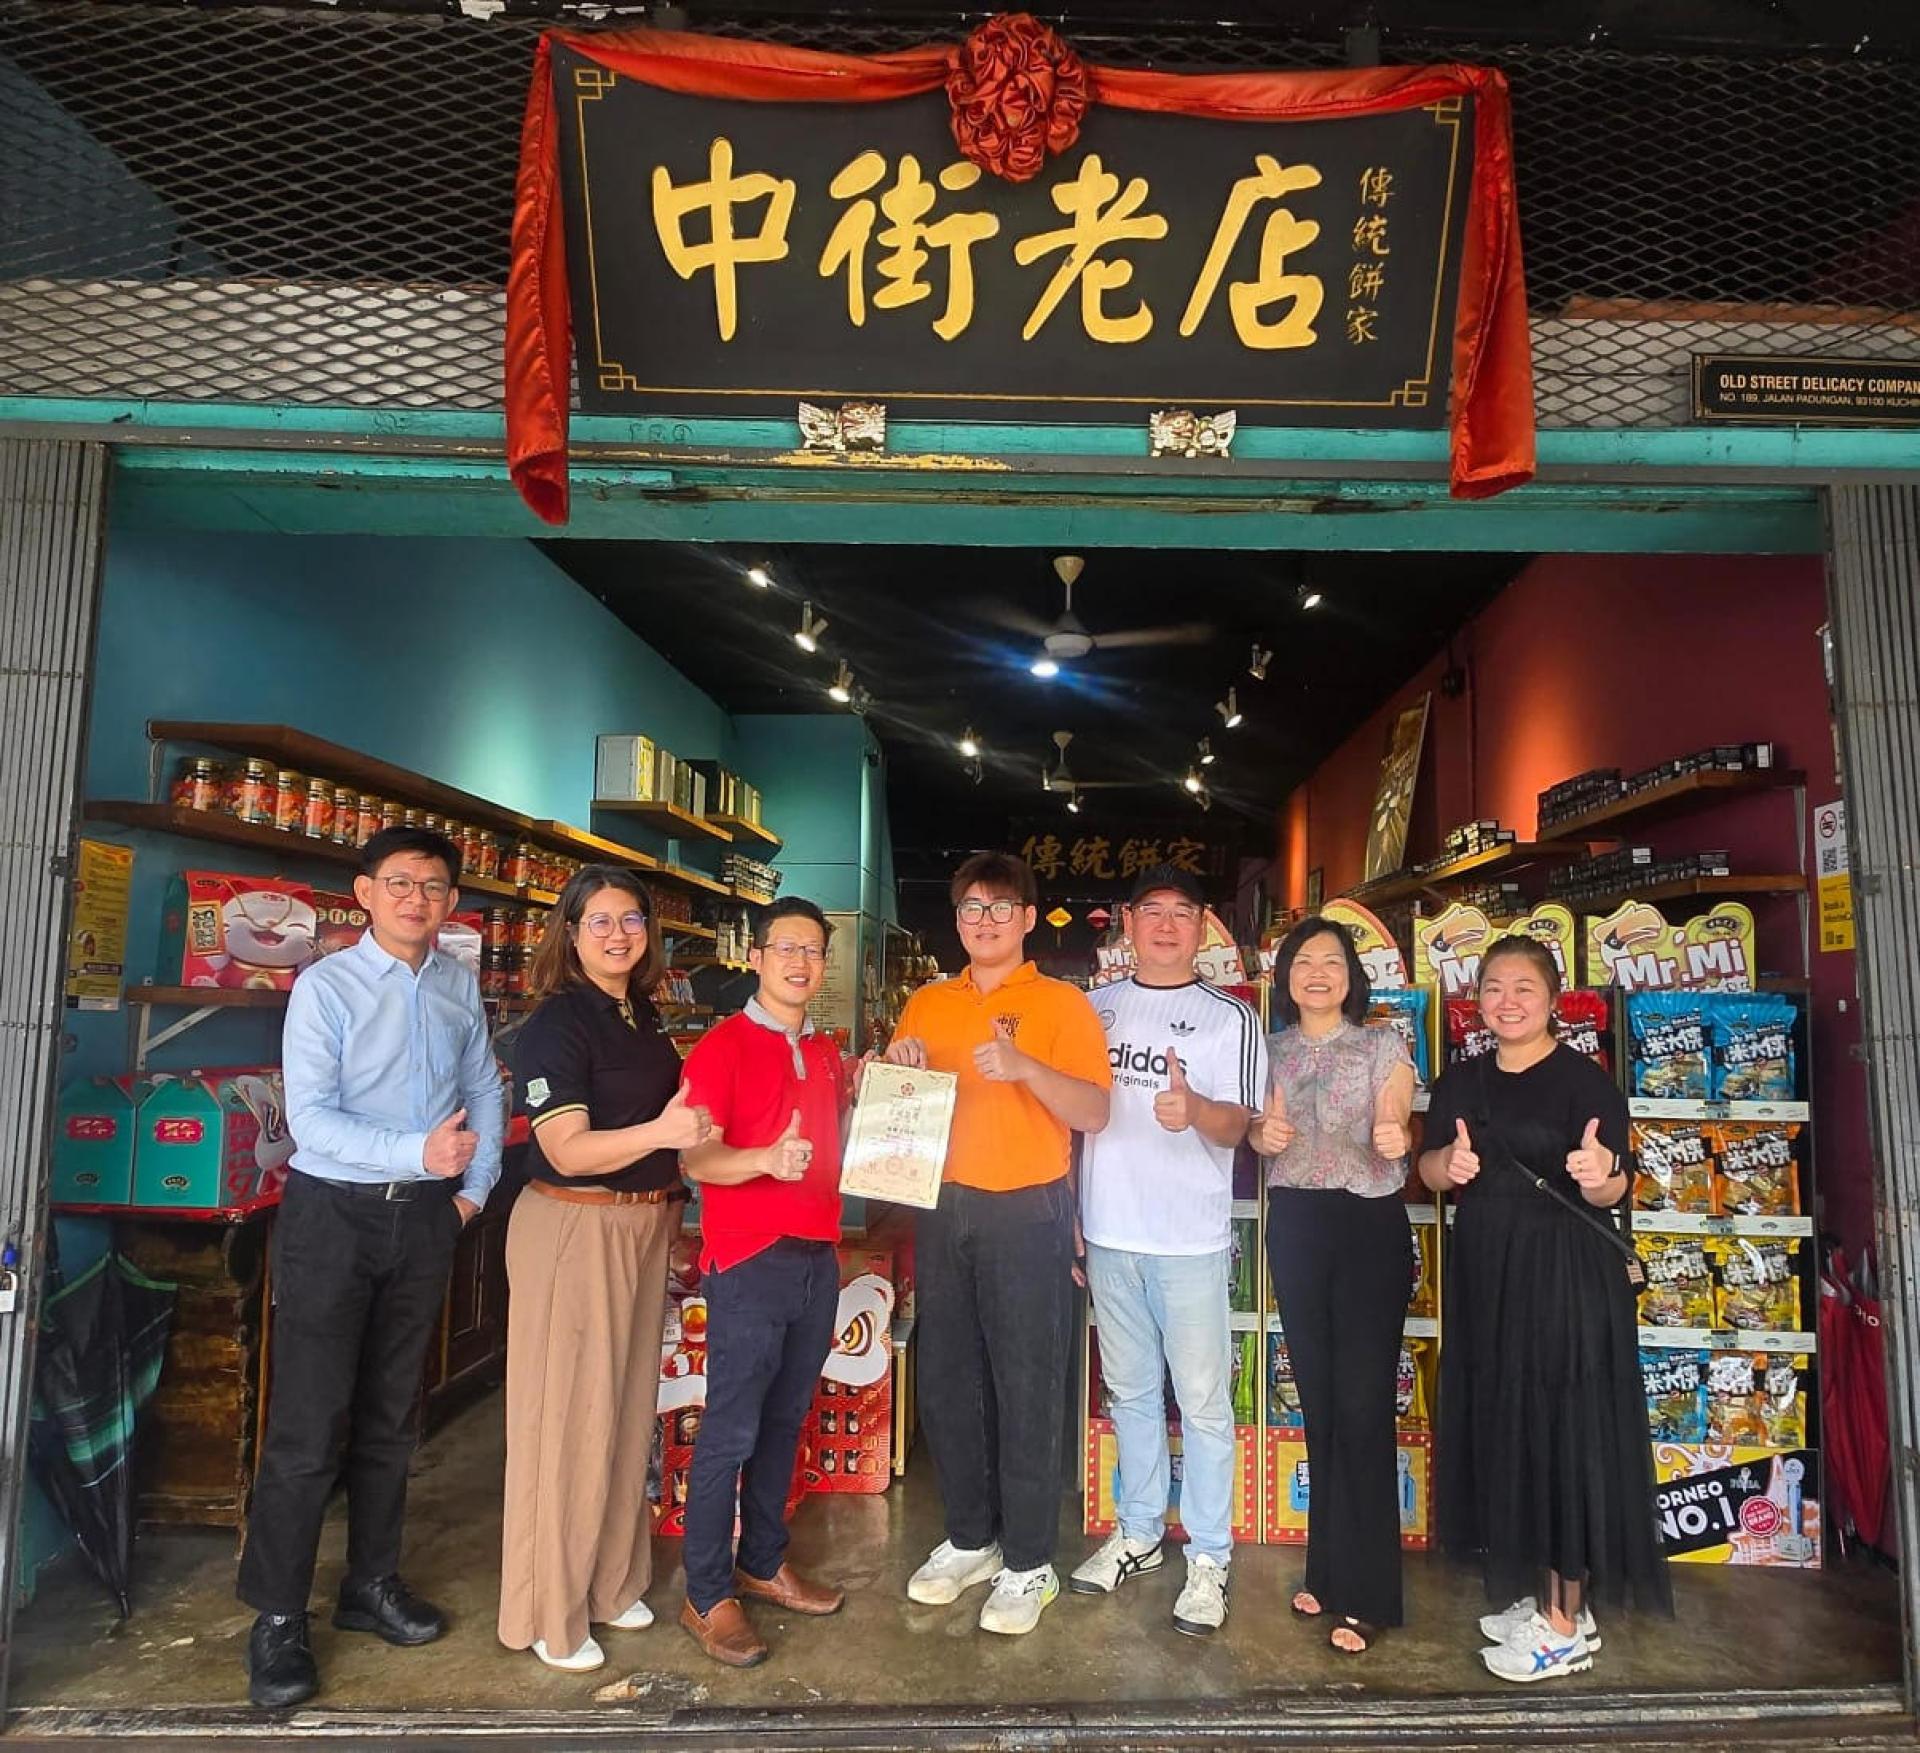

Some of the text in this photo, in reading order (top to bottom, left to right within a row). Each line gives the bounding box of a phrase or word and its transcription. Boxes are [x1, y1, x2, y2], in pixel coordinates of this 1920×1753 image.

[652, 137, 1325, 350] 中街老店
[1347, 167, 1396, 345] 傳統餅家
[1720, 374, 1746, 389] OLD
[1750, 375, 1799, 390] STREET
[1802, 376, 1864, 392] DELICACY
[1762, 393, 1795, 403] JALAN
[1021, 835, 1205, 879] 傳統餅家
[1107, 1043, 1187, 1077] didas
[1111, 1074, 1160, 1089] riginals
[1656, 1481, 1723, 1509] ORNEO
